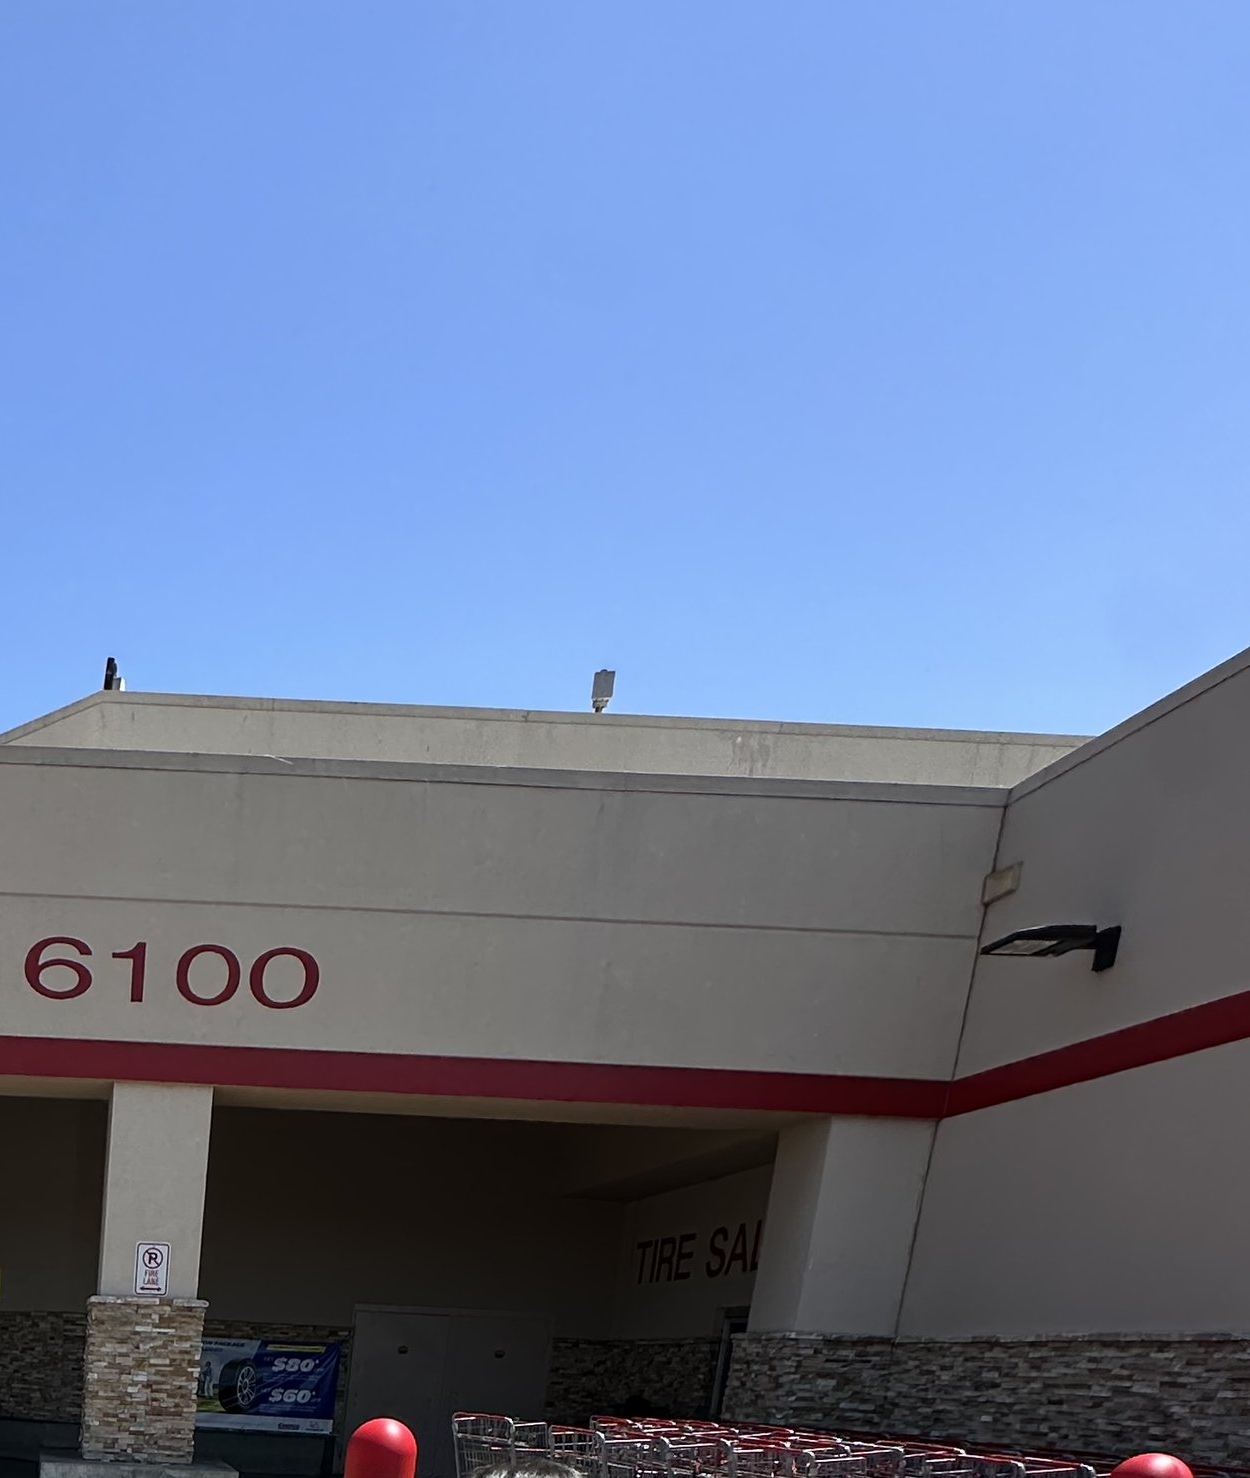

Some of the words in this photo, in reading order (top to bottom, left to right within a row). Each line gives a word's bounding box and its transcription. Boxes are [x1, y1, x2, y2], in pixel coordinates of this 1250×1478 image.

[24, 936, 320, 1010] 6100
[143, 1278, 159, 1286] LANE
[637, 1233, 697, 1284] TIRE
[706, 1219, 763, 1279] SAL
